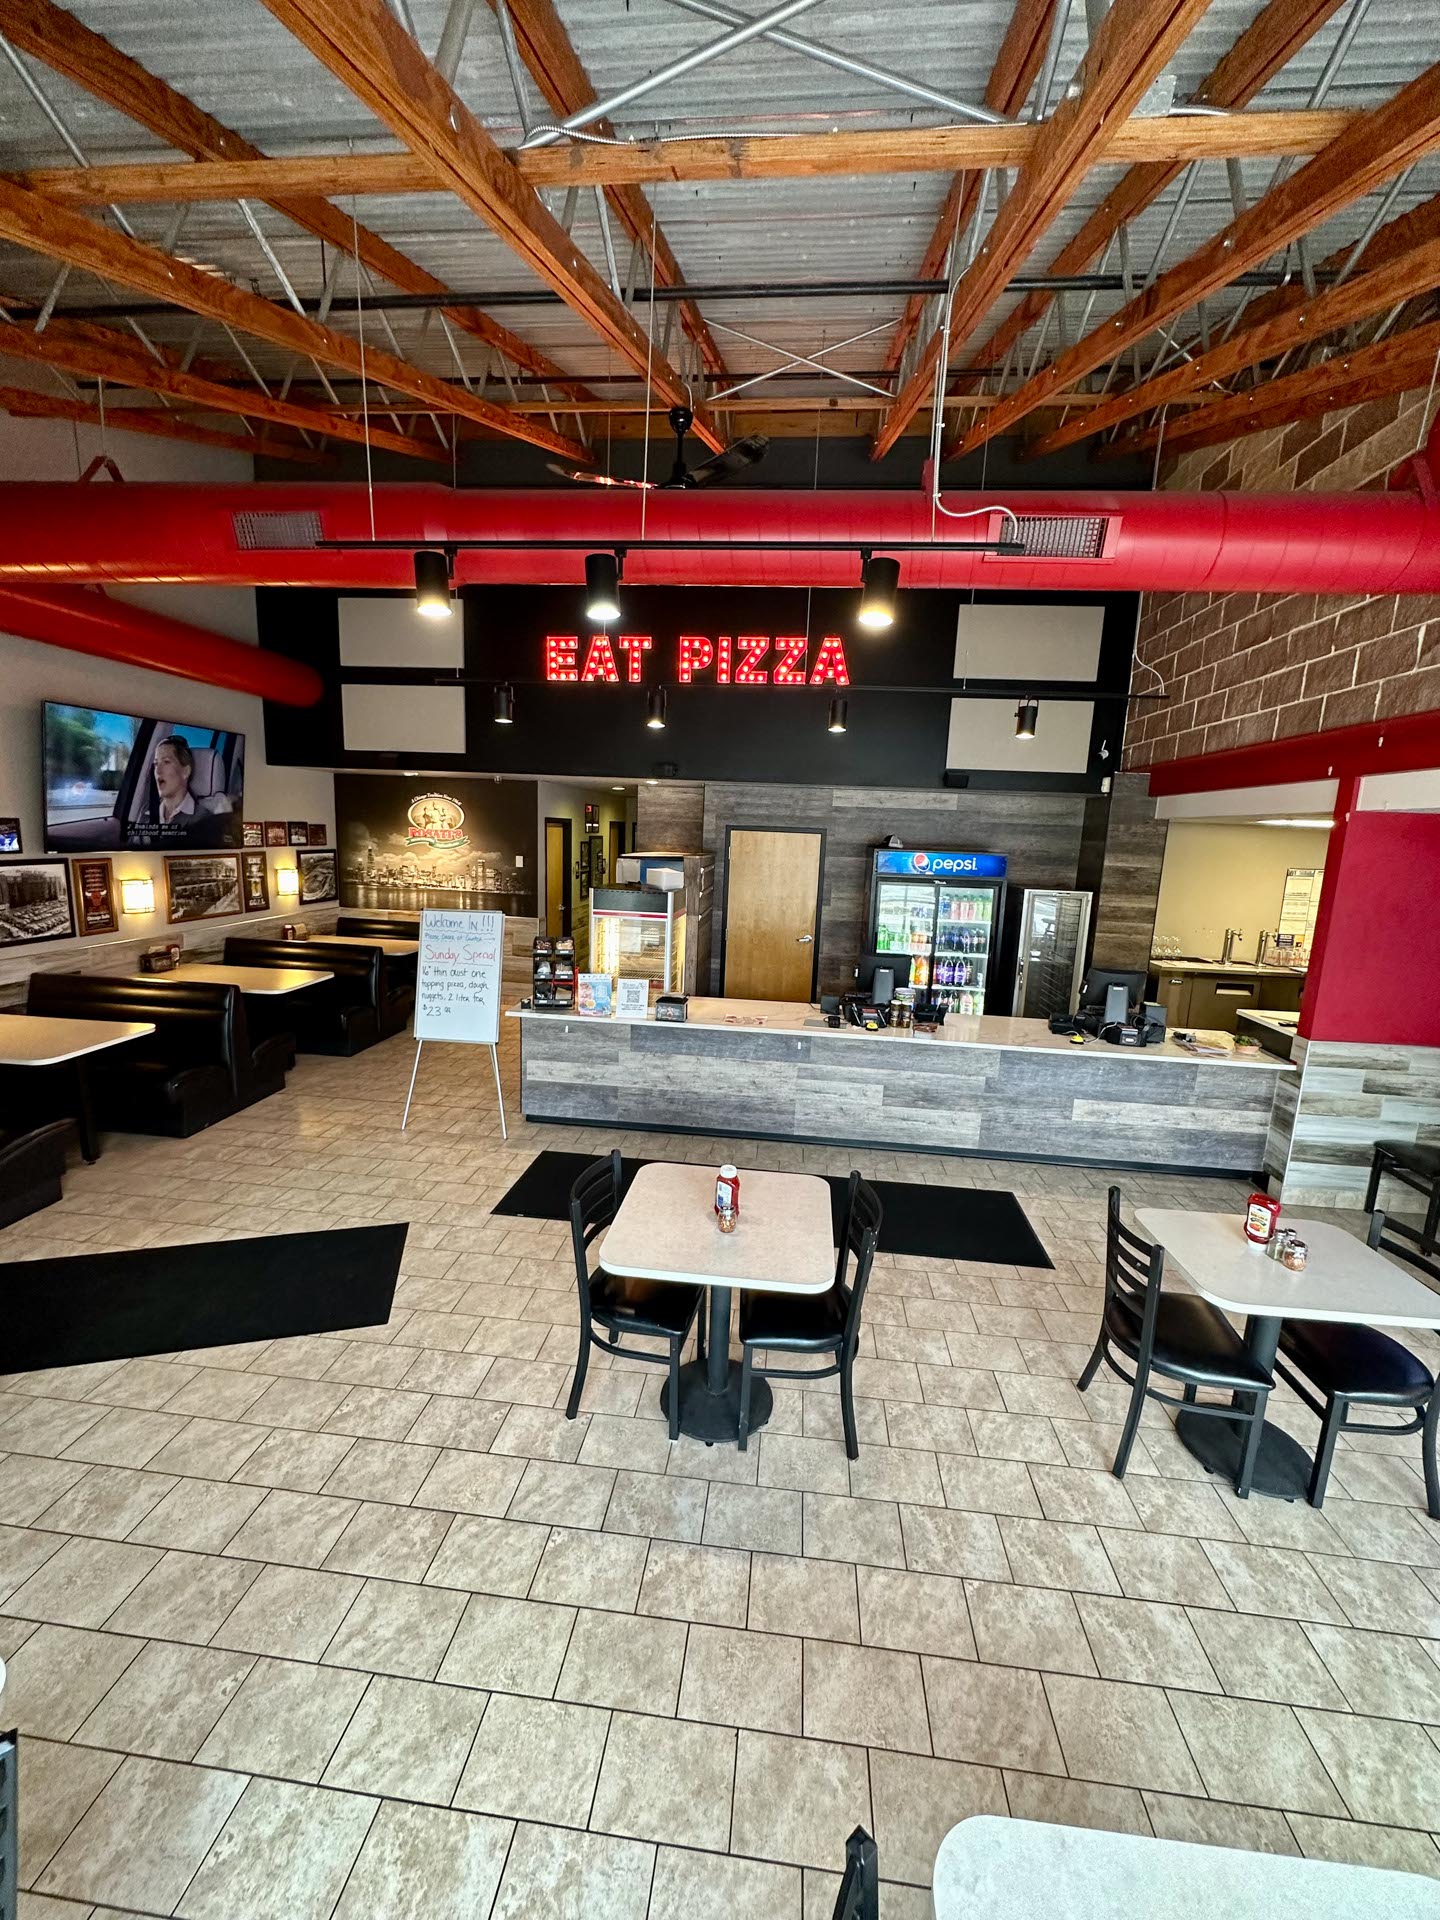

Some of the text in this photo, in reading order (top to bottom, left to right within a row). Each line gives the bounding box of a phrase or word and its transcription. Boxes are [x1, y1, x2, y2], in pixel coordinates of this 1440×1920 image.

[546, 635, 850, 685] EAT PIZZA
[408, 826, 464, 840] ROSATI'S
[932, 857, 977, 872] pepsi
[424, 913, 464, 928] Welcome
[424, 944, 460, 966] Sunday
[433, 966, 448, 976] thin
[471, 969, 486, 979] one
[421, 979, 445, 990] topping
[468, 980, 489, 993] dough
[448, 993, 454, 1001] 2
